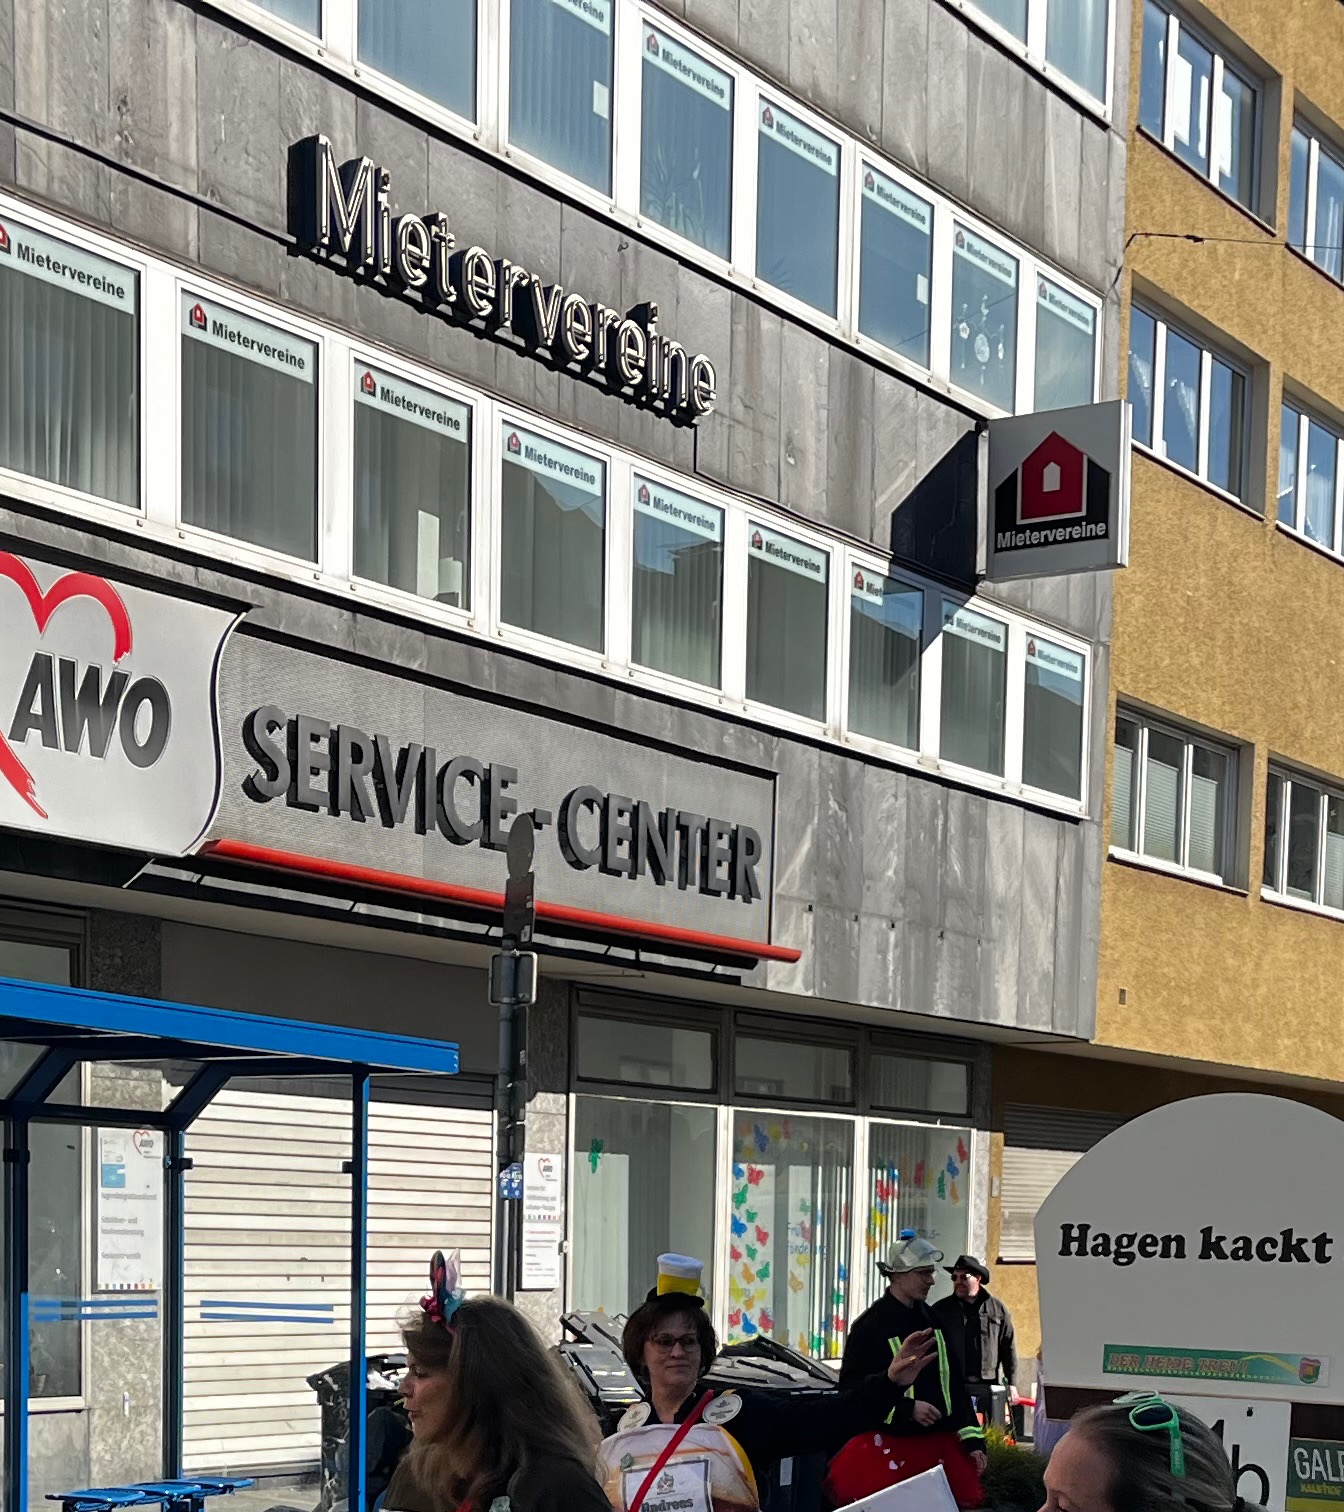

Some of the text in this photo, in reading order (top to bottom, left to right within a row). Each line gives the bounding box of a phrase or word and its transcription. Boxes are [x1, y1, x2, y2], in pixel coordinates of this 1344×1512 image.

[661, 47, 725, 99] Mietervereine
[775, 120, 833, 167] Mietervereine
[16, 242, 126, 300] Mietervereine
[315, 133, 717, 416] Mietervereine
[211, 320, 306, 371] Mietervereine
[380, 386, 461, 432] Mietervereine
[523, 445, 597, 487] Mietervereine
[652, 495, 716, 533] Mietervereine
[996, 521, 1107, 549] Mietervereine
[765, 541, 821, 574] Mietervereine
[7, 650, 172, 768] AWO
[1058, 1223, 1187, 1267] Hagen
[1198, 1226, 1334, 1264] kackt
